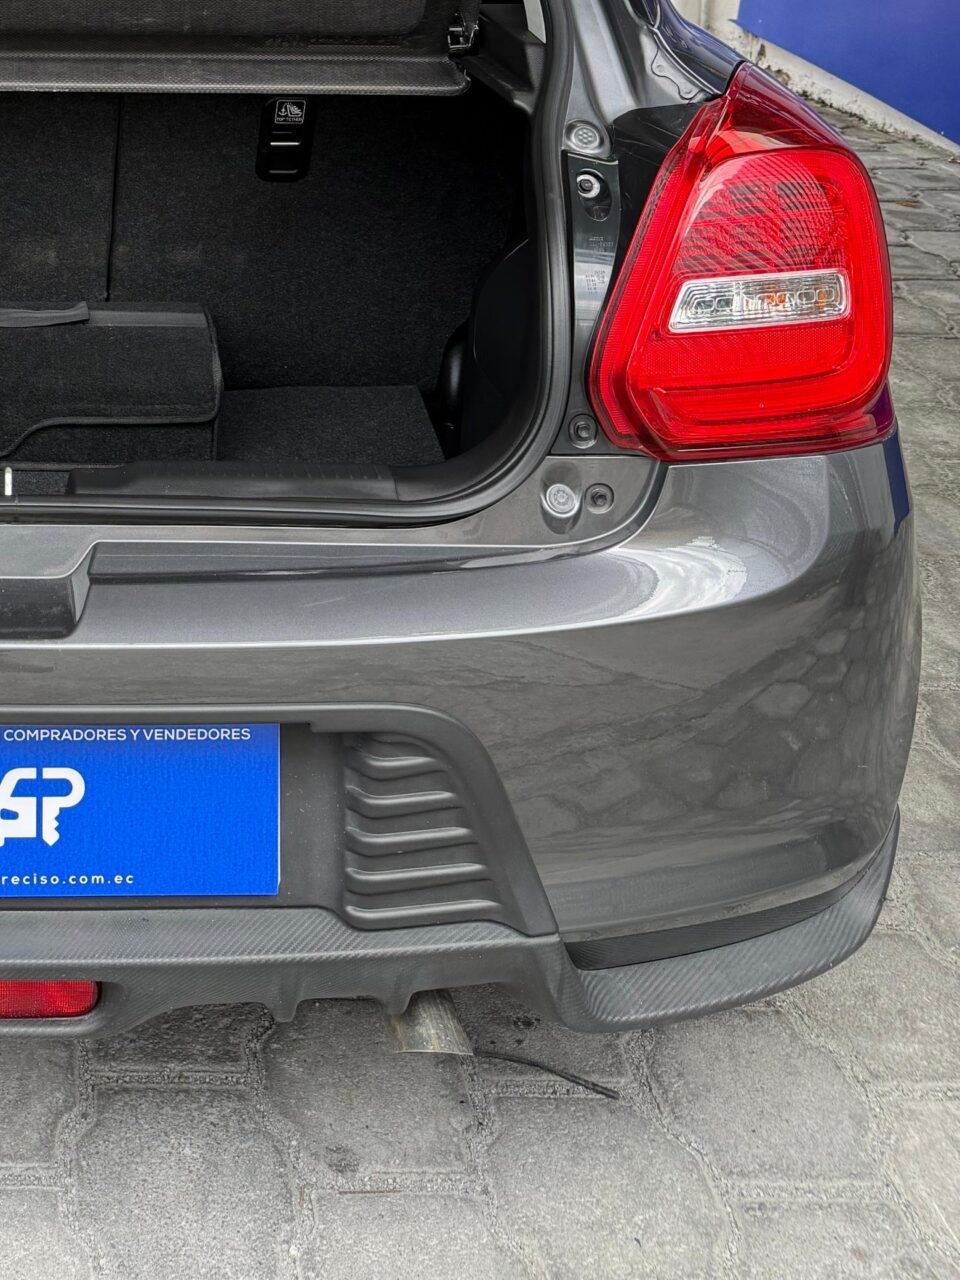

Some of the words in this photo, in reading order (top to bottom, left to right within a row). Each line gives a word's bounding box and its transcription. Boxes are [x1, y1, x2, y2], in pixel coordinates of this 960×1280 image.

[3, 728, 127, 741] COMPRADORES
[130, 729, 141, 741] Y
[142, 728, 252, 741] VENDEDORES
